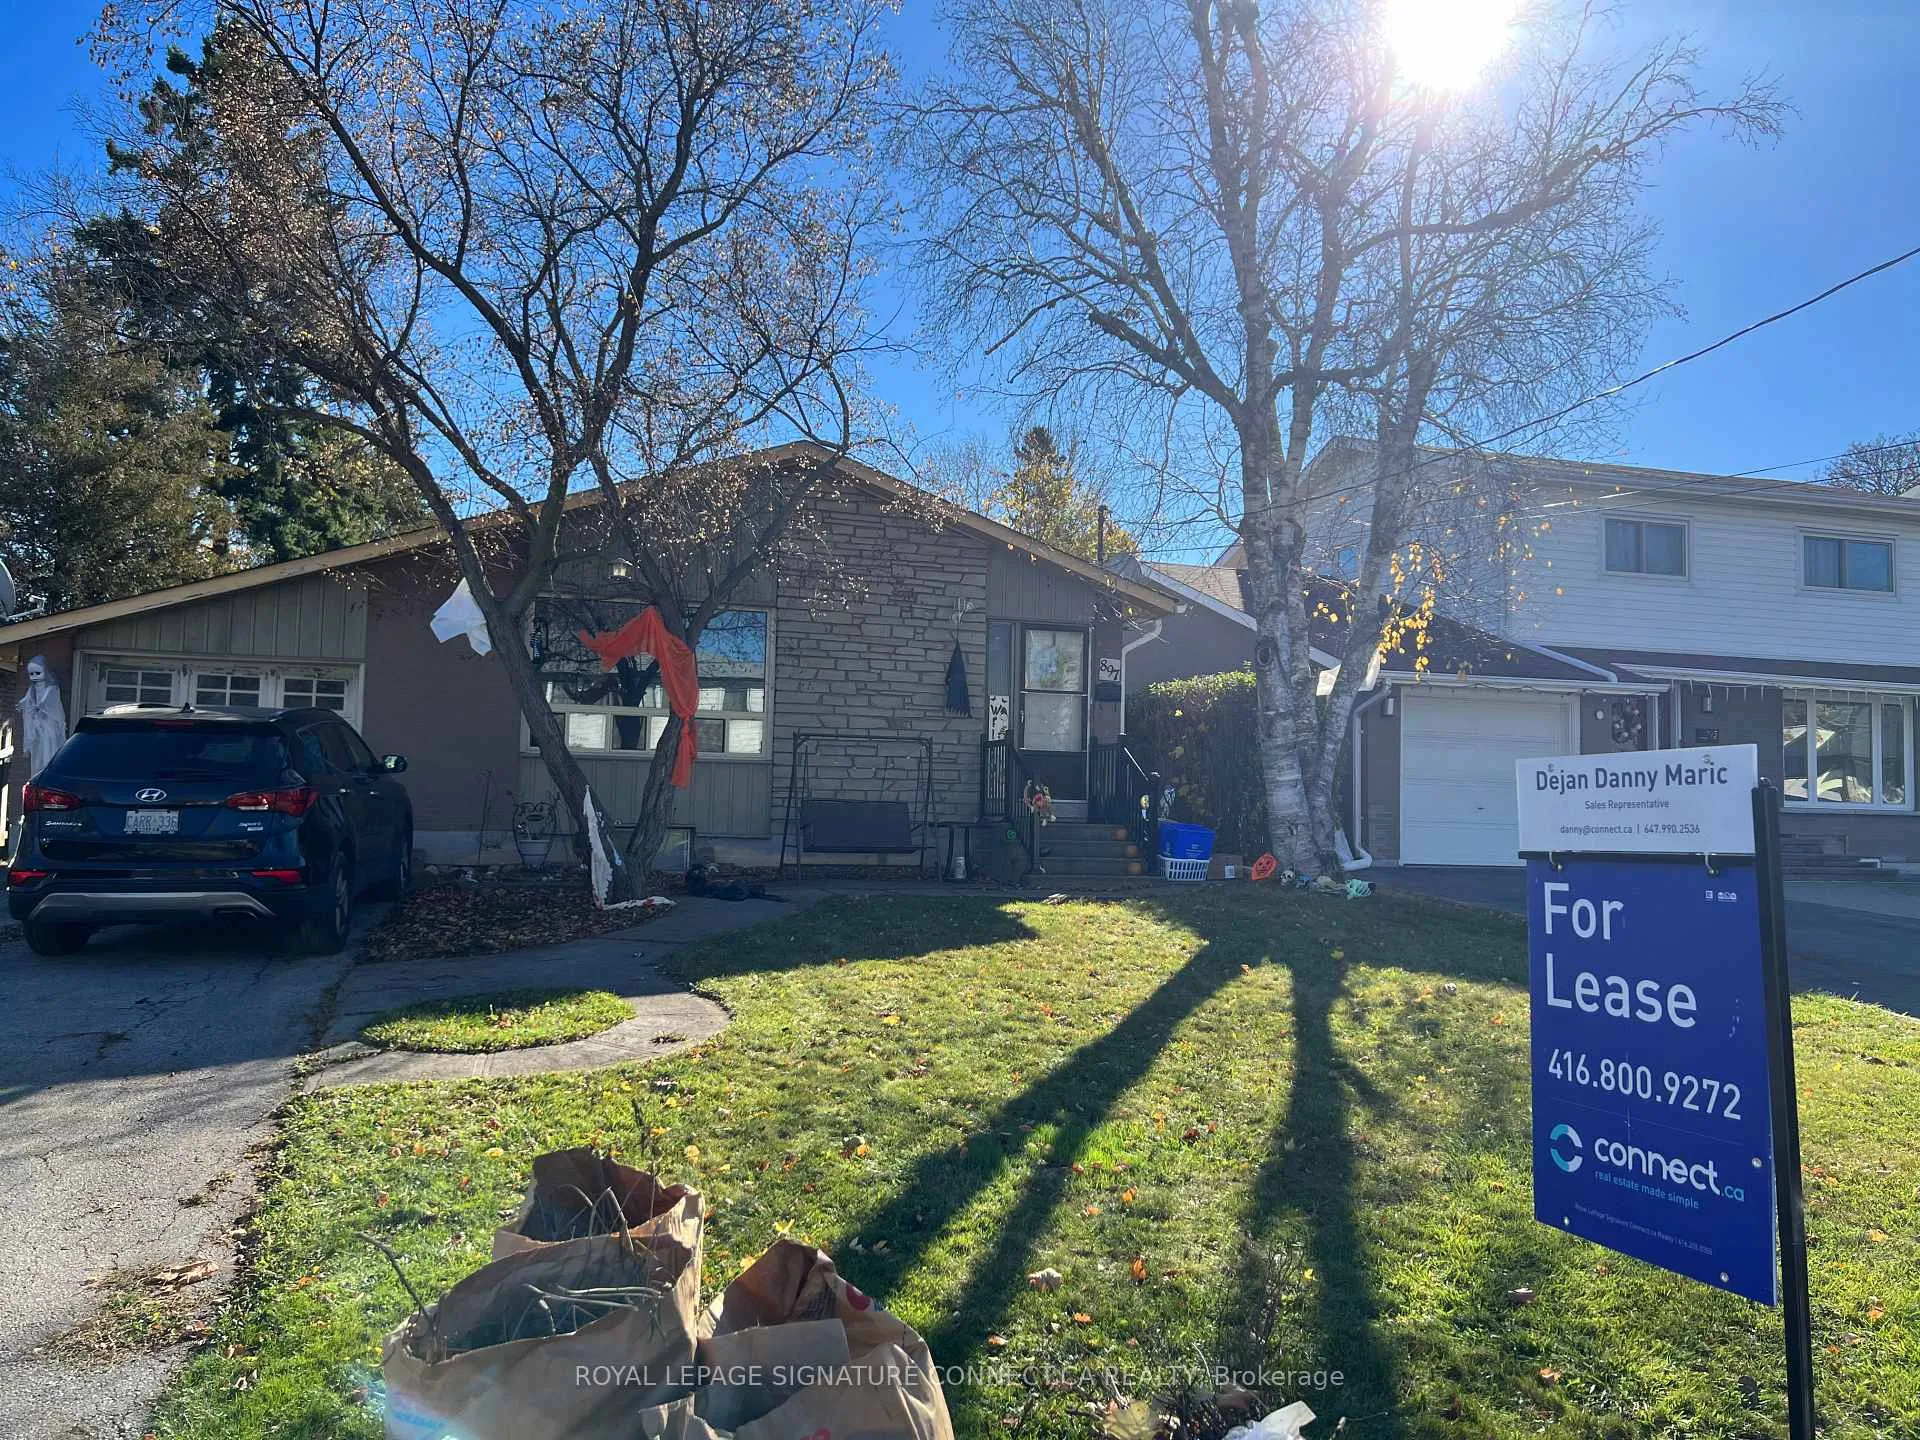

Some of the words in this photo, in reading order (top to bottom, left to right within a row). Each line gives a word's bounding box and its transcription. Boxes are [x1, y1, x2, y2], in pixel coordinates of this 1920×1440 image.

[1100, 659, 1120, 680] 897
[1535, 769, 1589, 795] Dejan
[1595, 766, 1658, 792] Danny
[1665, 762, 1729, 786] Maric
[1584, 800, 1606, 810] Sales
[1608, 799, 1670, 811] Representative
[1560, 824, 1633, 836] danny@connect.ca
[1644, 823, 1701, 834] 647.990.2536
[1543, 881, 1625, 940] For
[1545, 952, 1698, 1028] Lease
[1548, 1048, 1742, 1121] 416.800.9272
[1594, 1137, 1745, 1202] connect.ca
[1594, 1170, 1611, 1183] real
[1613, 1176, 1640, 1191] estate
[1641, 1183, 1666, 1199] made
[1668, 1191, 1700, 1209] simple
